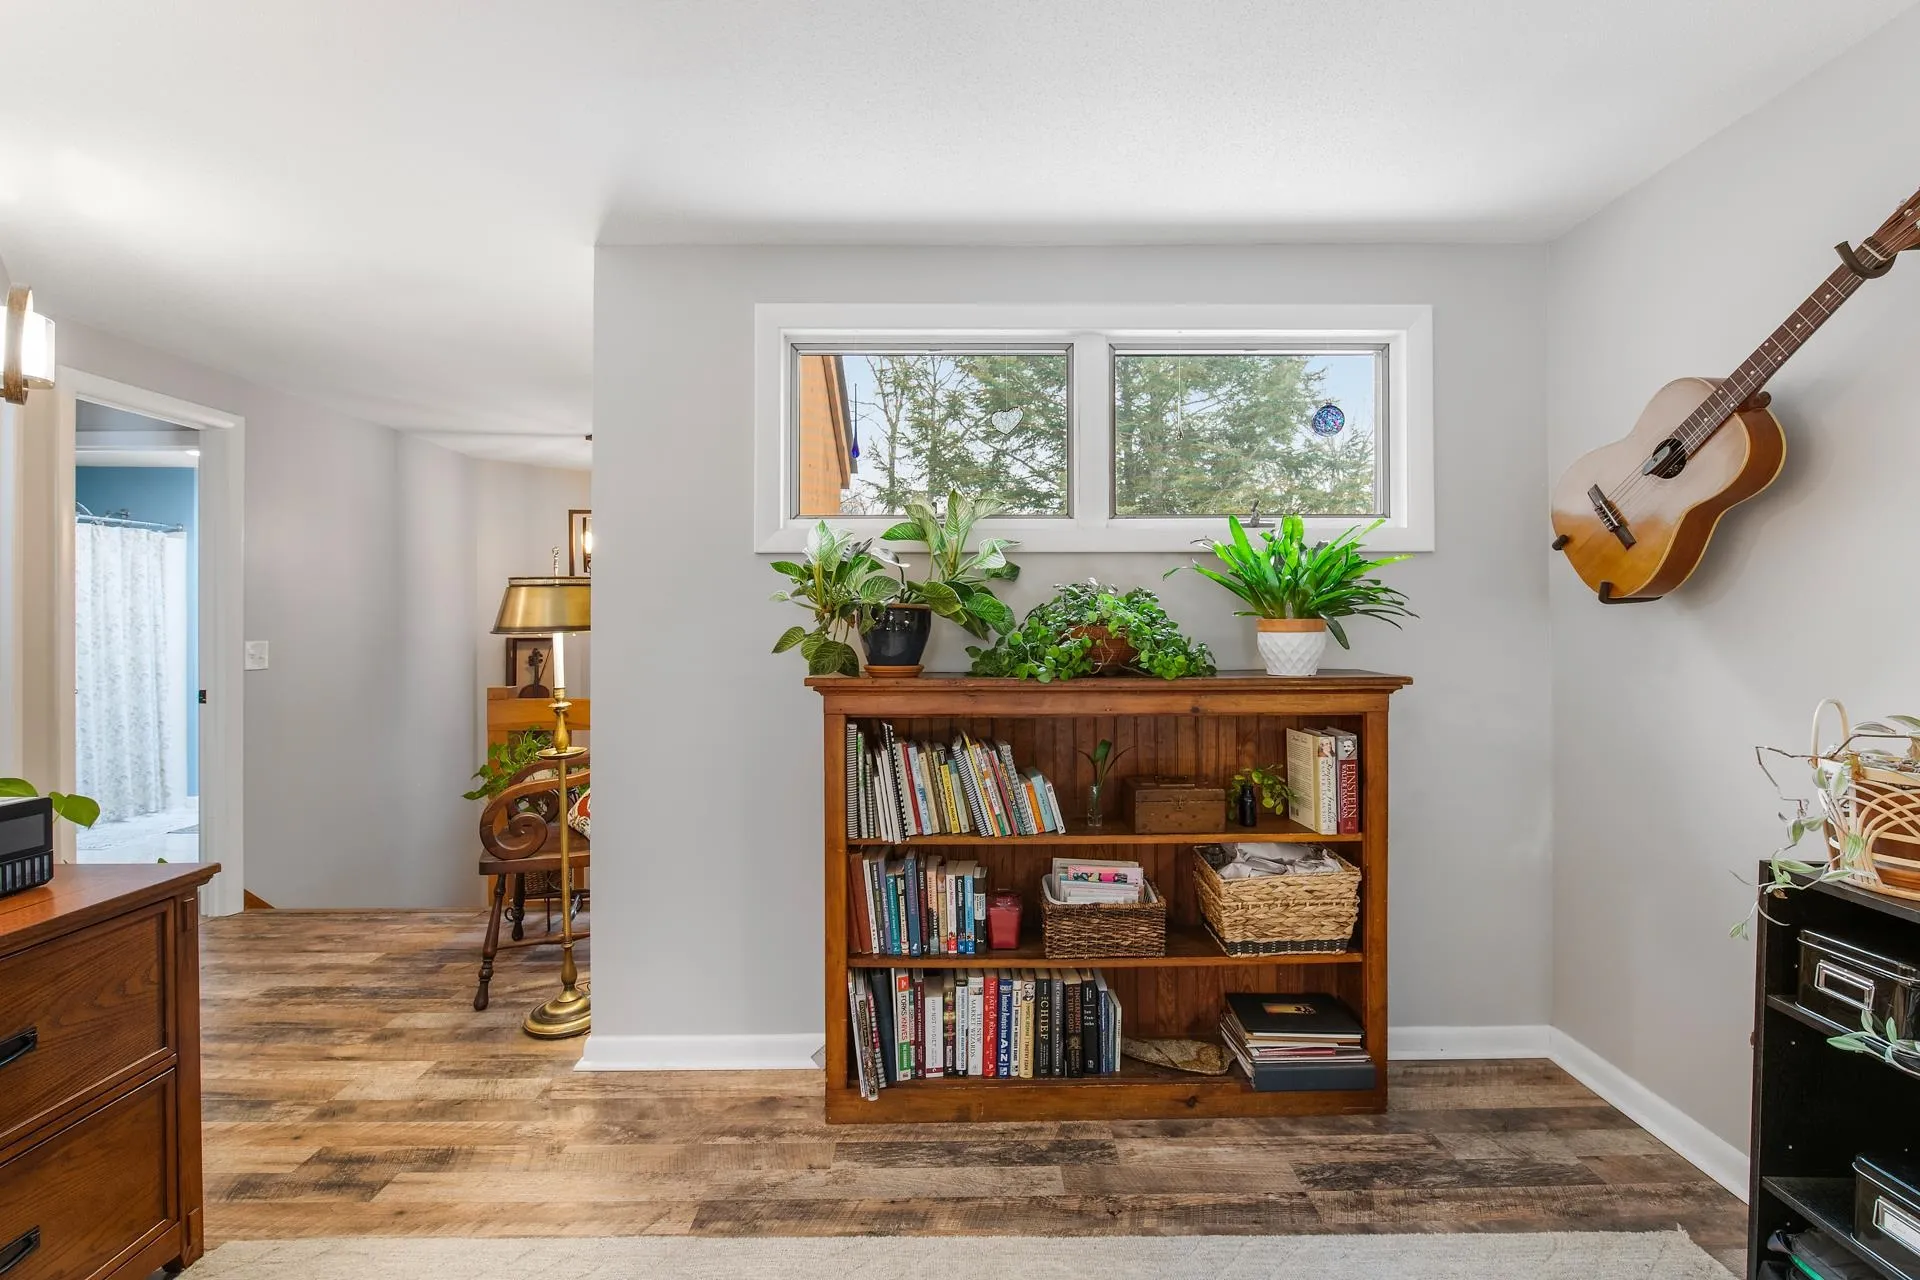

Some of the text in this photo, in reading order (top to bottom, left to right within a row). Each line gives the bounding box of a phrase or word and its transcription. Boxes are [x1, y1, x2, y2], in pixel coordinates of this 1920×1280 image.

[1347, 764, 1356, 818] EINSTEIN
[1068, 987, 1073, 997] OF
[1001, 994, 1010, 1011] Technical
[901, 1016, 909, 1041] KNIVES
[1001, 1012, 1010, 1029] Analysis
[1040, 1000, 1048, 1040] CHIEF
[1001, 1039, 1008, 1048] A
[1001, 1053, 1007, 1062] Z
